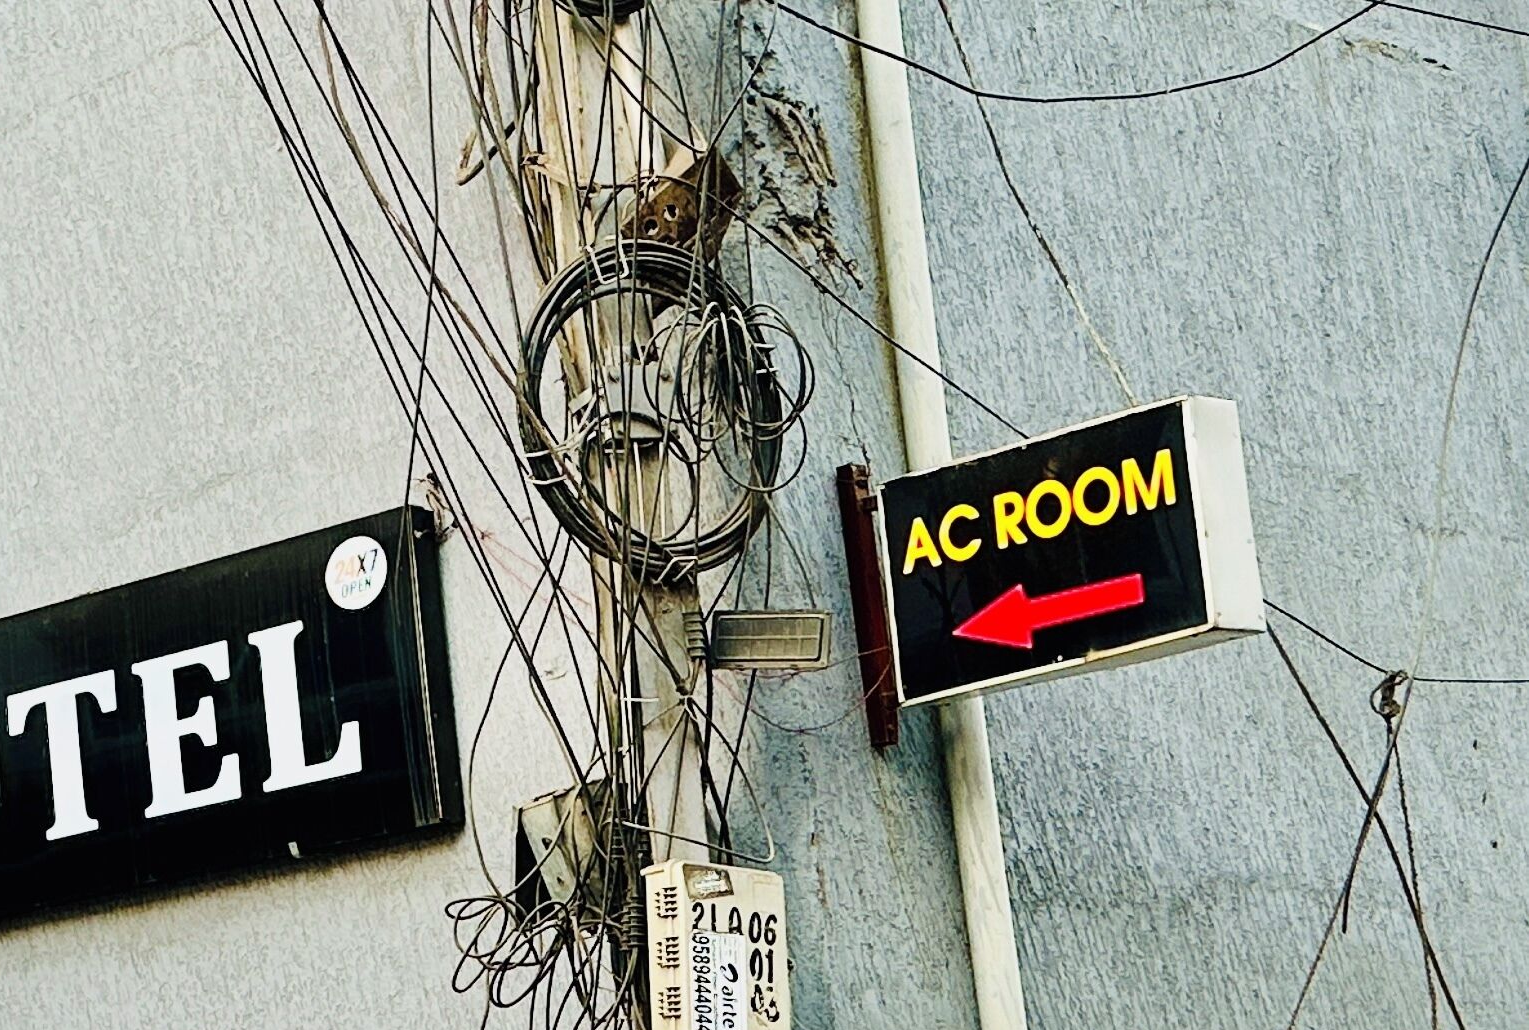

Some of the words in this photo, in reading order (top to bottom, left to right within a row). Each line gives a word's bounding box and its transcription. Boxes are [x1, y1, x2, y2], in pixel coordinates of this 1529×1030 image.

[902, 503, 982, 575] AC
[993, 448, 1177, 550] ROOM
[341, 577, 371, 598] OPEN
